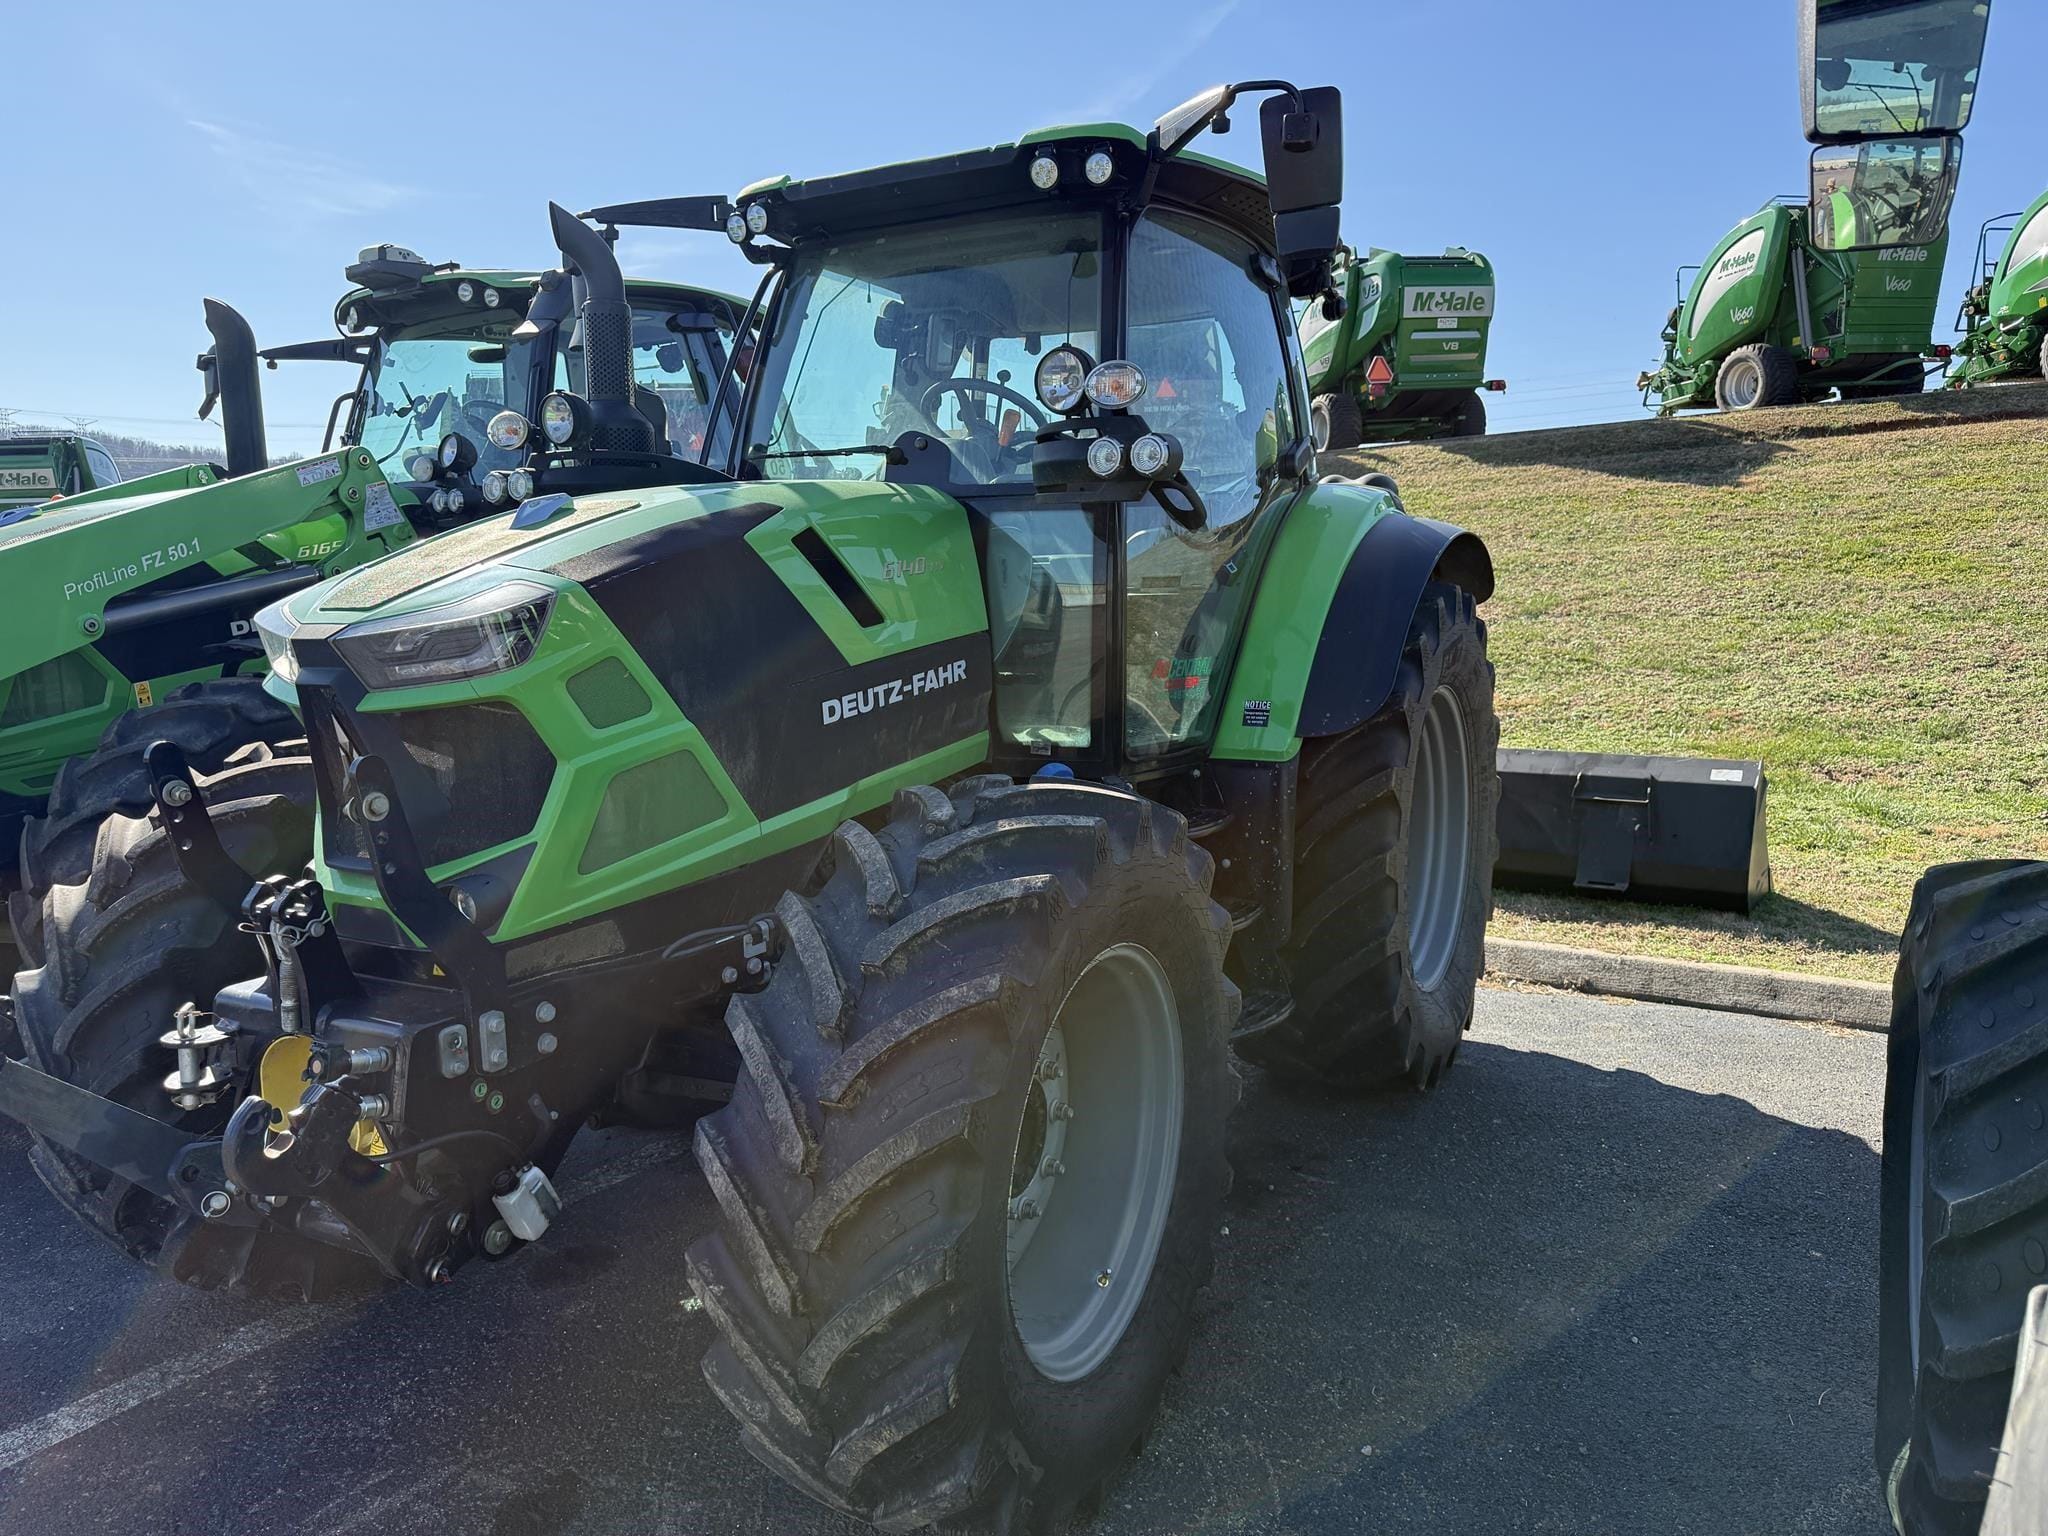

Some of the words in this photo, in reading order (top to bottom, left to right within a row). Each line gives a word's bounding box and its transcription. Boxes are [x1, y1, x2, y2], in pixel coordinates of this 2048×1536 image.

[1878, 246, 1927, 261] McHale
[1362, 283, 1379, 299] V8
[1886, 275, 1911, 291] V660
[1412, 291, 1486, 312] McHale
[1730, 305, 1754, 323] V660
[1442, 341, 1459, 350] V8
[0, 472, 48, 486] cHale
[64, 563, 138, 600] ProfiLine
[141, 551, 165, 572] FZ
[168, 537, 200, 561] 50.1
[822, 660, 967, 725] DEUTZ-FAHR
[1245, 700, 1271, 709] NOTICE
